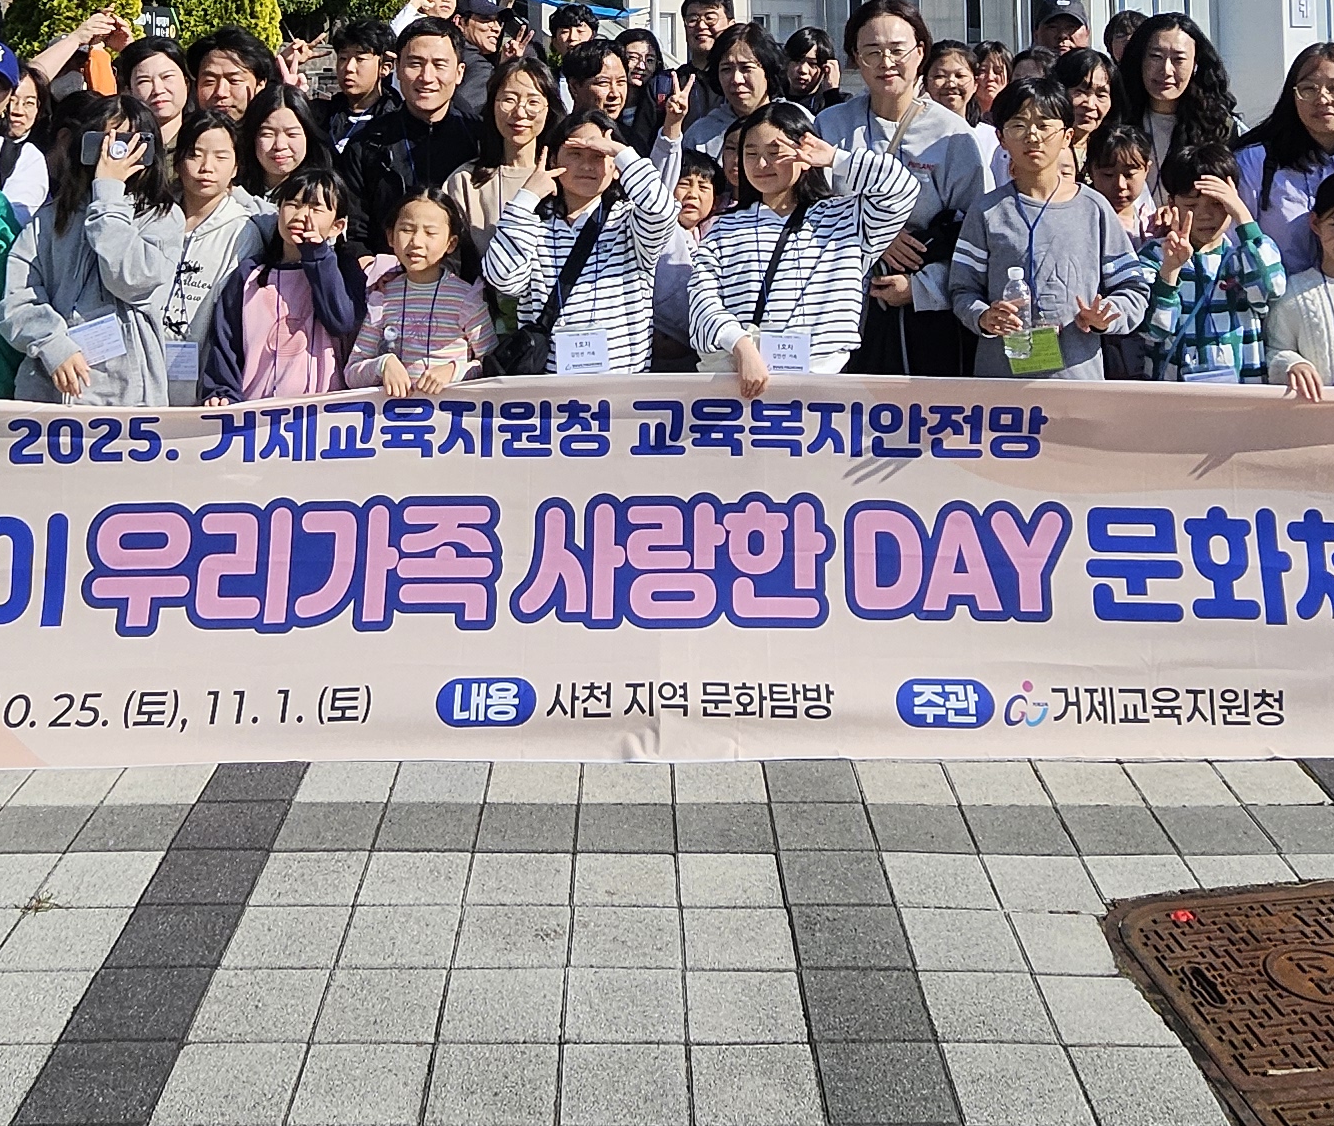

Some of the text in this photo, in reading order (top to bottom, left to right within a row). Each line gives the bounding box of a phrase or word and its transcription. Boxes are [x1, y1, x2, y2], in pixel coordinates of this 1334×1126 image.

[7, 400, 1049, 465] 2025. 거제교육지원청 교육복지안전망
[82, 494, 500, 635] 우리가족
[510, 492, 835, 631] 사랑한
[843, 498, 1073, 626] DAY
[48, 693, 109, 727] 25.
[122, 690, 188, 733] (토),
[205, 690, 260, 724] 11.
[276, 688, 305, 723] 1.
[317, 685, 373, 727] (토)
[452, 680, 835, 722] 내용 사천 지역 문화탐방
[912, 684, 979, 724] 주관
[1050, 686, 1286, 727] 거제교육지원청
